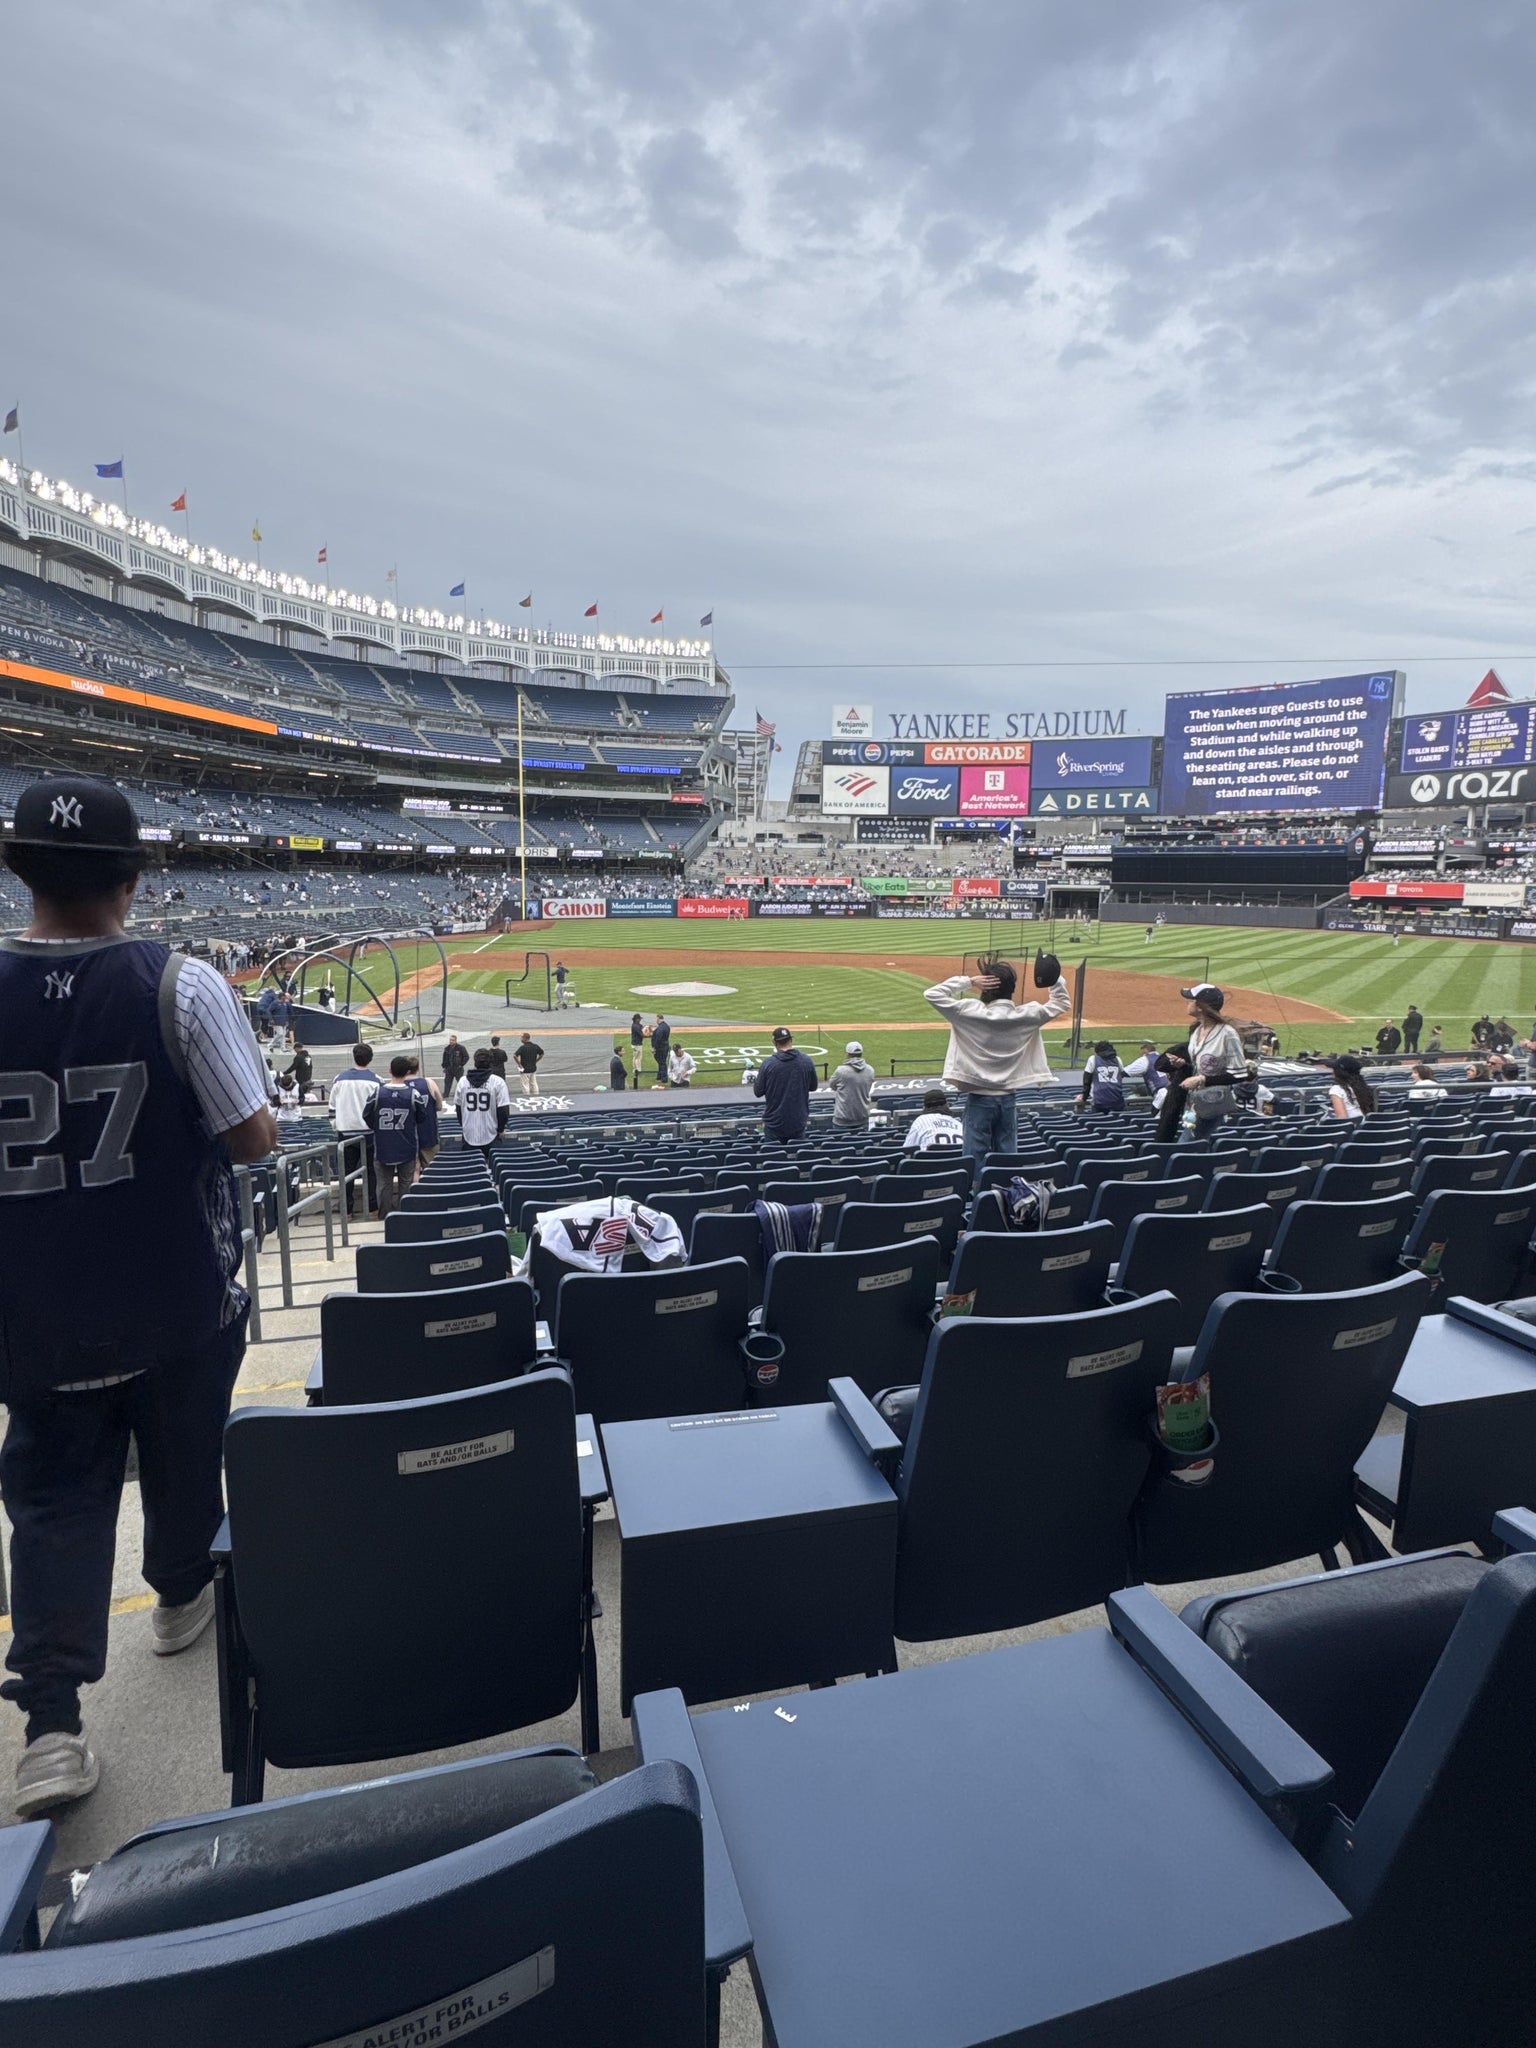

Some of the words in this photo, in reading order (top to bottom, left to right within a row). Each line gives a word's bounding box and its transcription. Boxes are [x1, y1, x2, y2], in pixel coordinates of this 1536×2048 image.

[32, 633, 65, 649] VODKA
[102, 653, 130, 667] ASPEN
[1189, 710, 1210, 720] The
[1211, 706, 1257, 718] Yankees
[1259, 704, 1284, 715] urge
[1286, 700, 1325, 712] Guests
[1327, 698, 1339, 708] to
[1341, 696, 1363, 706] use
[837, 720, 868, 728] Benjamin
[888, 713, 990, 739] YANKEE
[1005, 709, 1128, 738] STADIUM
[1184, 722, 1224, 733] caution
[1226, 720, 1257, 731] when
[1259, 716, 1302, 729] moving
[1303, 711, 1345, 724] around
[1346, 710, 1367, 720] the
[1190, 735, 1235, 746] Stadium
[1236, 733, 1258, 743] and
[1259, 730, 1291, 741] while
[1293, 727, 1340, 738] walking
[1342, 726, 1358, 737] up
[890, 749, 914, 757] PEPSI
[930, 746, 1025, 761] GATORADE
[1183, 749, 1204, 760] and
[1205, 749, 1235, 759] down
[1237, 747, 1257, 756] the
[1258, 744, 1290, 755] aisles
[1292, 742, 1314, 753] and
[1315, 739, 1363, 751] through
[1407, 746, 1430, 756] STOLEN
[1430, 745, 1450, 754] BASES
[1185, 763, 1207, 773] the
[1205, 761, 1246, 772] seating
[1247, 760, 1281, 770] areas.
[1282, 757, 1320, 768] Please
[1322, 755, 1336, 765] do
[1338, 753, 1359, 764] not
[1415, 754, 1441, 763] LEADERS
[1069, 762, 1126, 774] RiverSpring
[1192, 776, 1216, 786] lean
[1217, 776, 1236, 786] on,
[1236, 773, 1267, 784] reach
[1269, 773, 1297, 783] over,
[1298, 770, 1314, 781] sit
[1315, 770, 1334, 780] on,
[1336, 770, 1350, 778] or
[1446, 769, 1529, 800] razr
[897, 777, 952, 800] Ford
[1215, 788, 1247, 798] stand
[1248, 787, 1273, 797] near
[1275, 785, 1321, 797] railings.
[961, 802, 984, 810] Best
[984, 802, 1026, 810] Network
[969, 794, 1018, 802] America's
[1066, 792, 1151, 810] DELTA
[885, 882, 906, 891] Eats
[1016, 882, 1039, 891] coupa
[1399, 886, 1424, 894] TOYOTA
[543, 901, 605, 916] Canon
[984, 911, 1006, 919] STARR
[1362, 923, 1387, 932] STARR
[1096, 1066, 1120, 1084] 27
[465, 1091, 491, 1112] 99
[378, 1107, 410, 1131] 27
[0, 1061, 149, 1196] 27
[416, 1459, 438, 1469] BATS
[439, 1452, 472, 1465] AND/OR
[473, 1445, 498, 1458] BALLS
[430, 1450, 442, 1459] BE
[443, 1445, 468, 1457] ALERT
[469, 1441, 485, 1450] FOR
[448, 1991, 511, 2032] BALLS
[363, 2015, 428, 2048] ALERT
[435, 1996, 475, 2023] FOR
